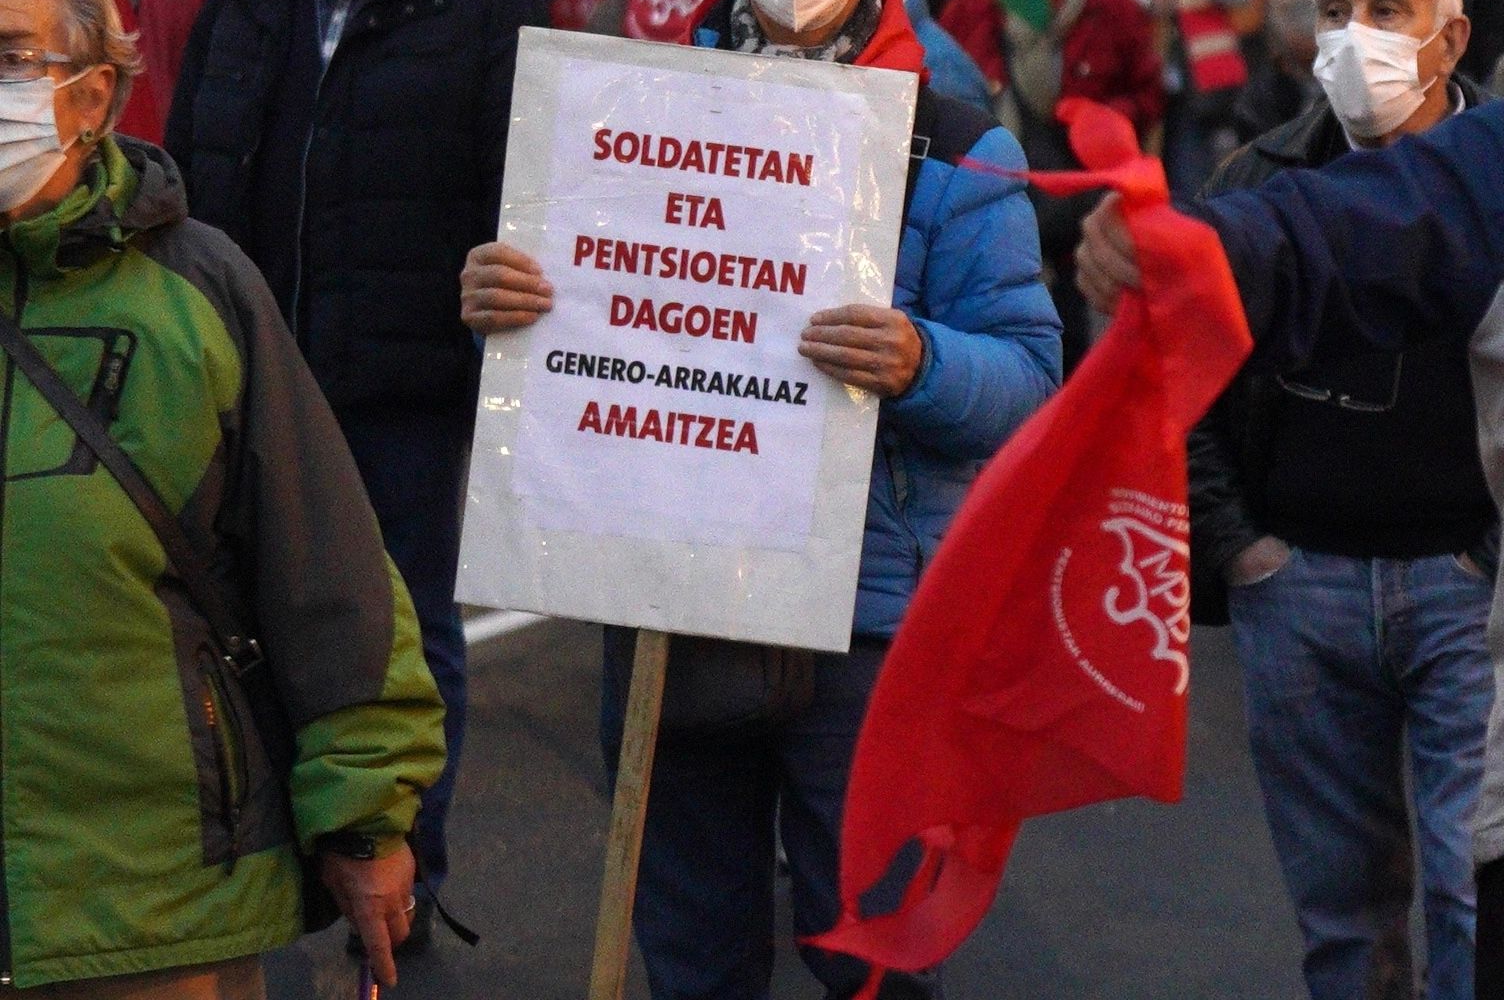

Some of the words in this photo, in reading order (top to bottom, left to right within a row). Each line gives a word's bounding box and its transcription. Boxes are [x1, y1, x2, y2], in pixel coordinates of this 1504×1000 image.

[593, 129, 813, 186] SOLDATETAN
[665, 192, 725, 231] ETA
[573, 235, 807, 295] PENTSIOETAN
[610, 296, 757, 343] DAGOEN
[546, 350, 808, 405] GENERO-ARRAKALAZ
[578, 402, 759, 454] AMAITZEA
